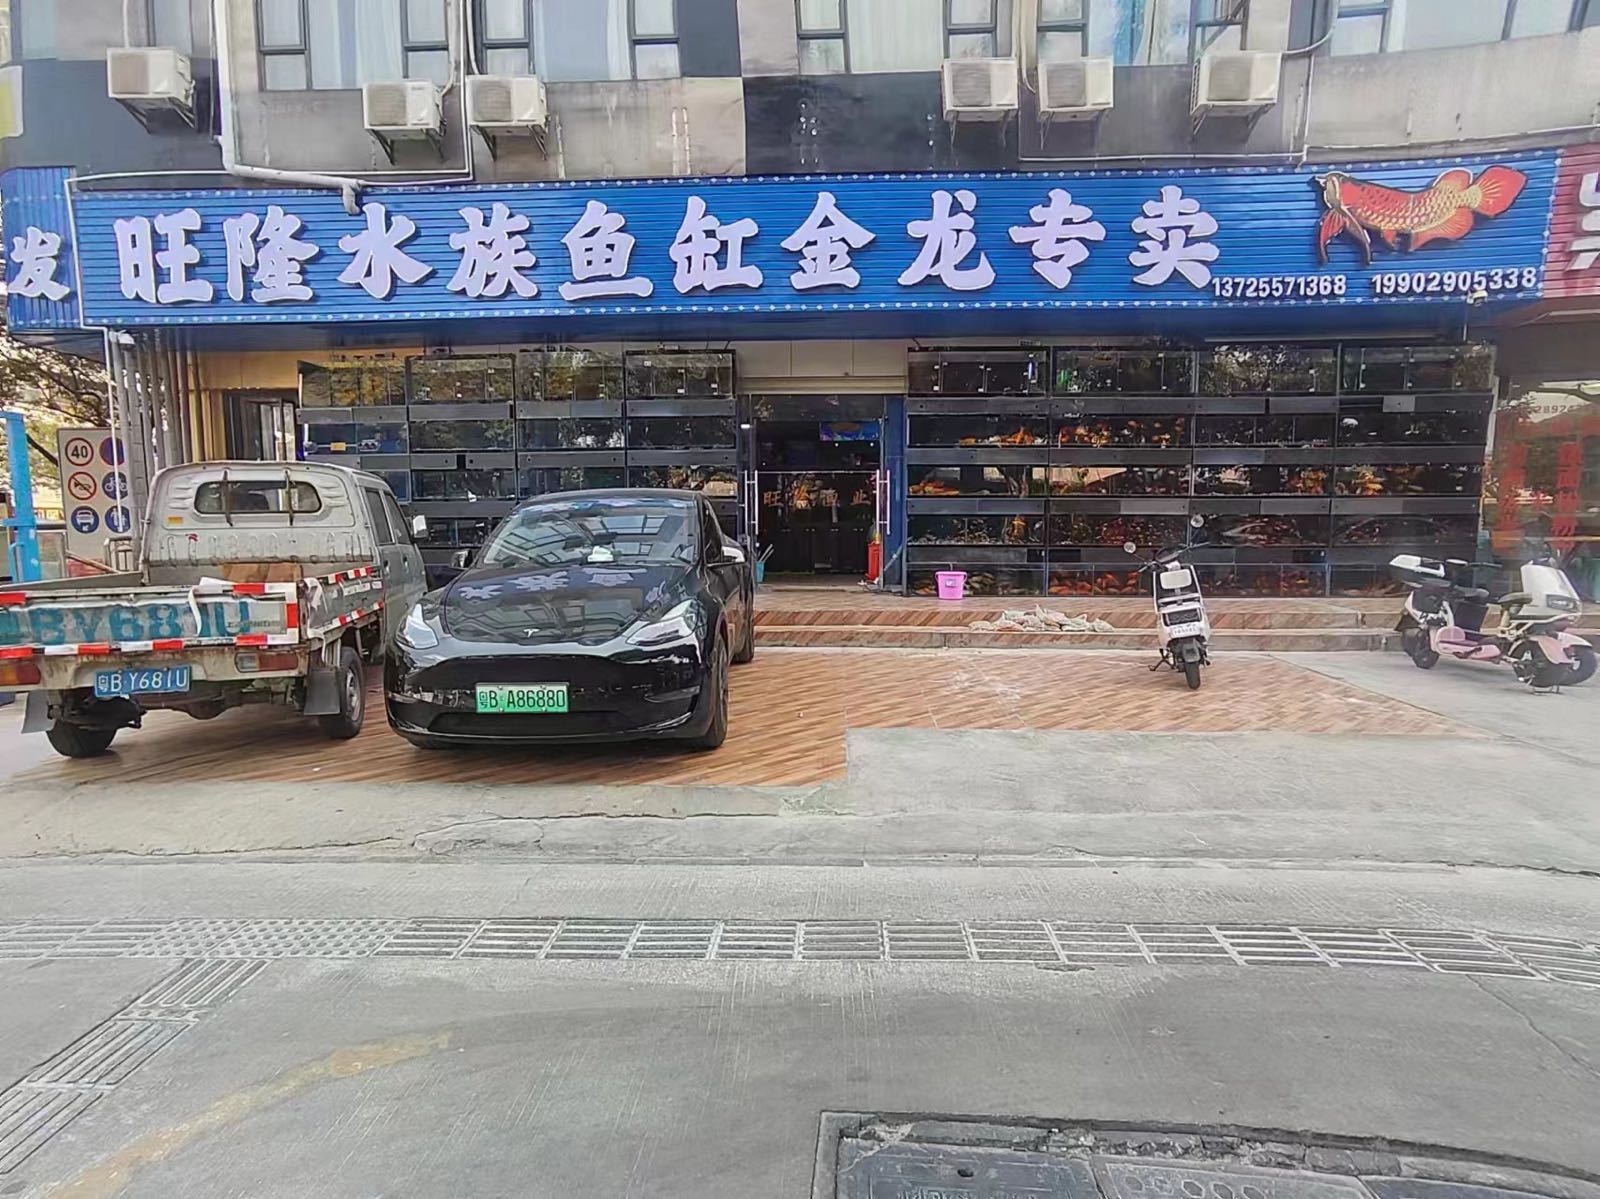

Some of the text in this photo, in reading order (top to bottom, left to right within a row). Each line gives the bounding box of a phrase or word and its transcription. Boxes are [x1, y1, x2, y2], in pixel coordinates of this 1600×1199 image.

[9, 227, 70, 301] 发
[114, 184, 1221, 305] 旺隆水族鱼缸金龙专卖
[1212, 268, 1537, 297] 13725571368 19902905338
[72, 446, 89, 461] 40
